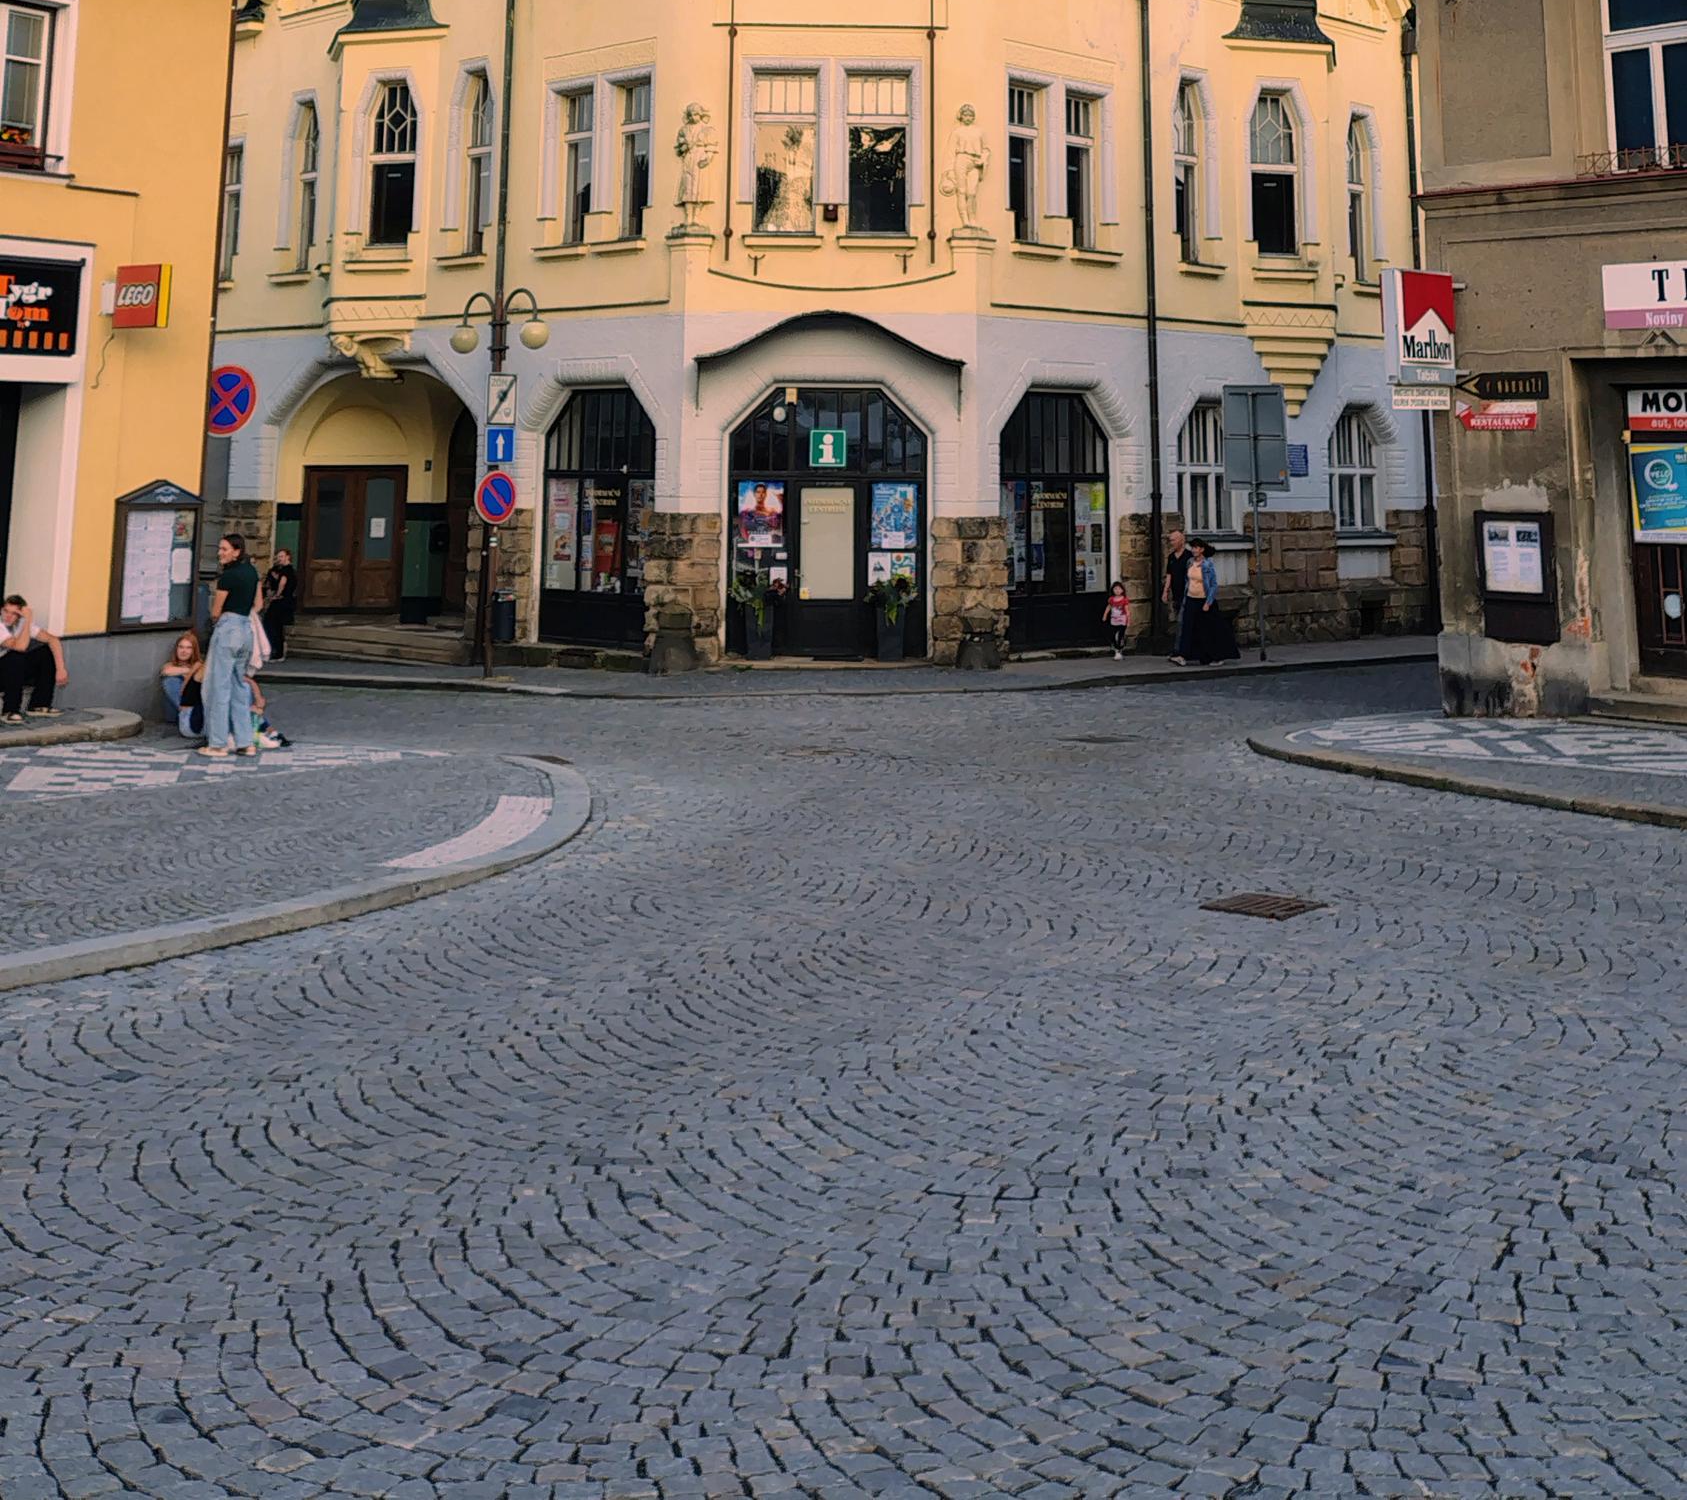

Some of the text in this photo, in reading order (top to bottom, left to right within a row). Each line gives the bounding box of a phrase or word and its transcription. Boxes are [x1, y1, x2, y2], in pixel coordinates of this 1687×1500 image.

[117, 284, 155, 307] LEGO
[1645, 311, 1684, 327] Noviny
[1641, 392, 1687, 413] MO
[1470, 417, 1530, 427] RESTAURANT
